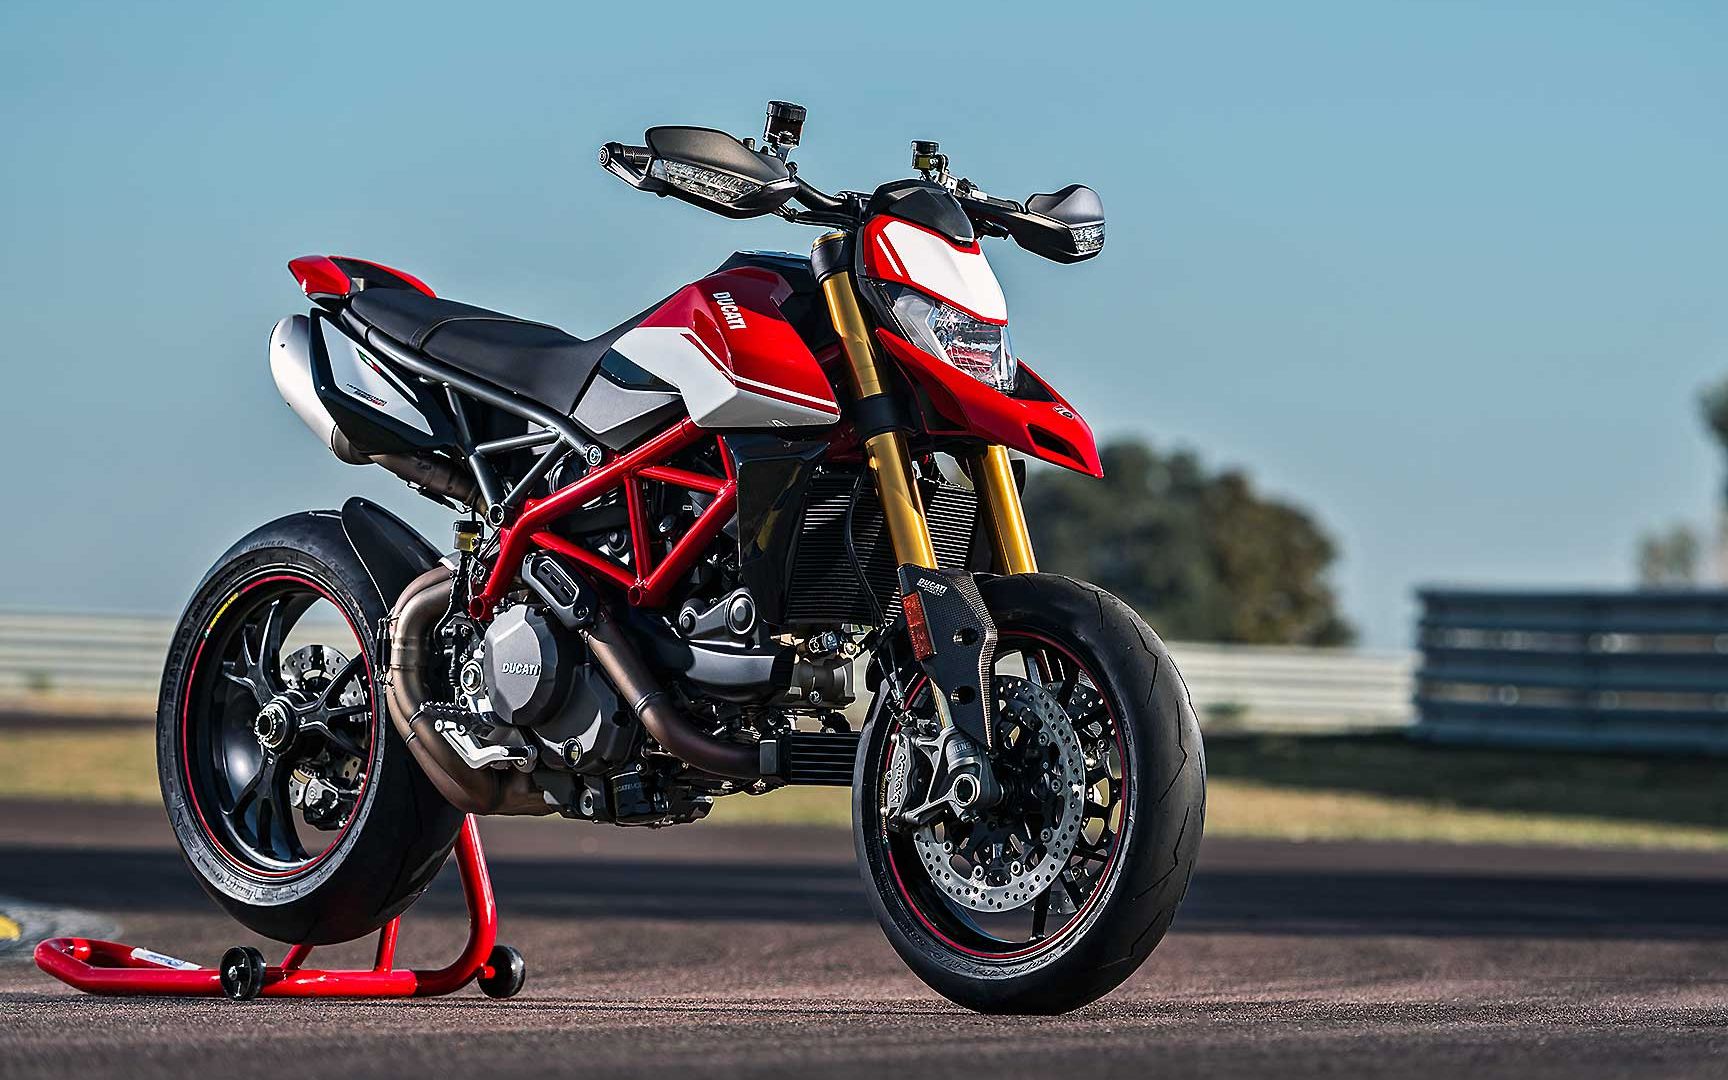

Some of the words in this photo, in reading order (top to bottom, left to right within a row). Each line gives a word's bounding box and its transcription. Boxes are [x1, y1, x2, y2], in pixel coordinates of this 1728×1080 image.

[713, 292, 747, 330] DUCATI
[917, 578, 948, 593] DUCATI
[502, 662, 540, 677] DUCATI
[890, 753, 906, 804] brembo
